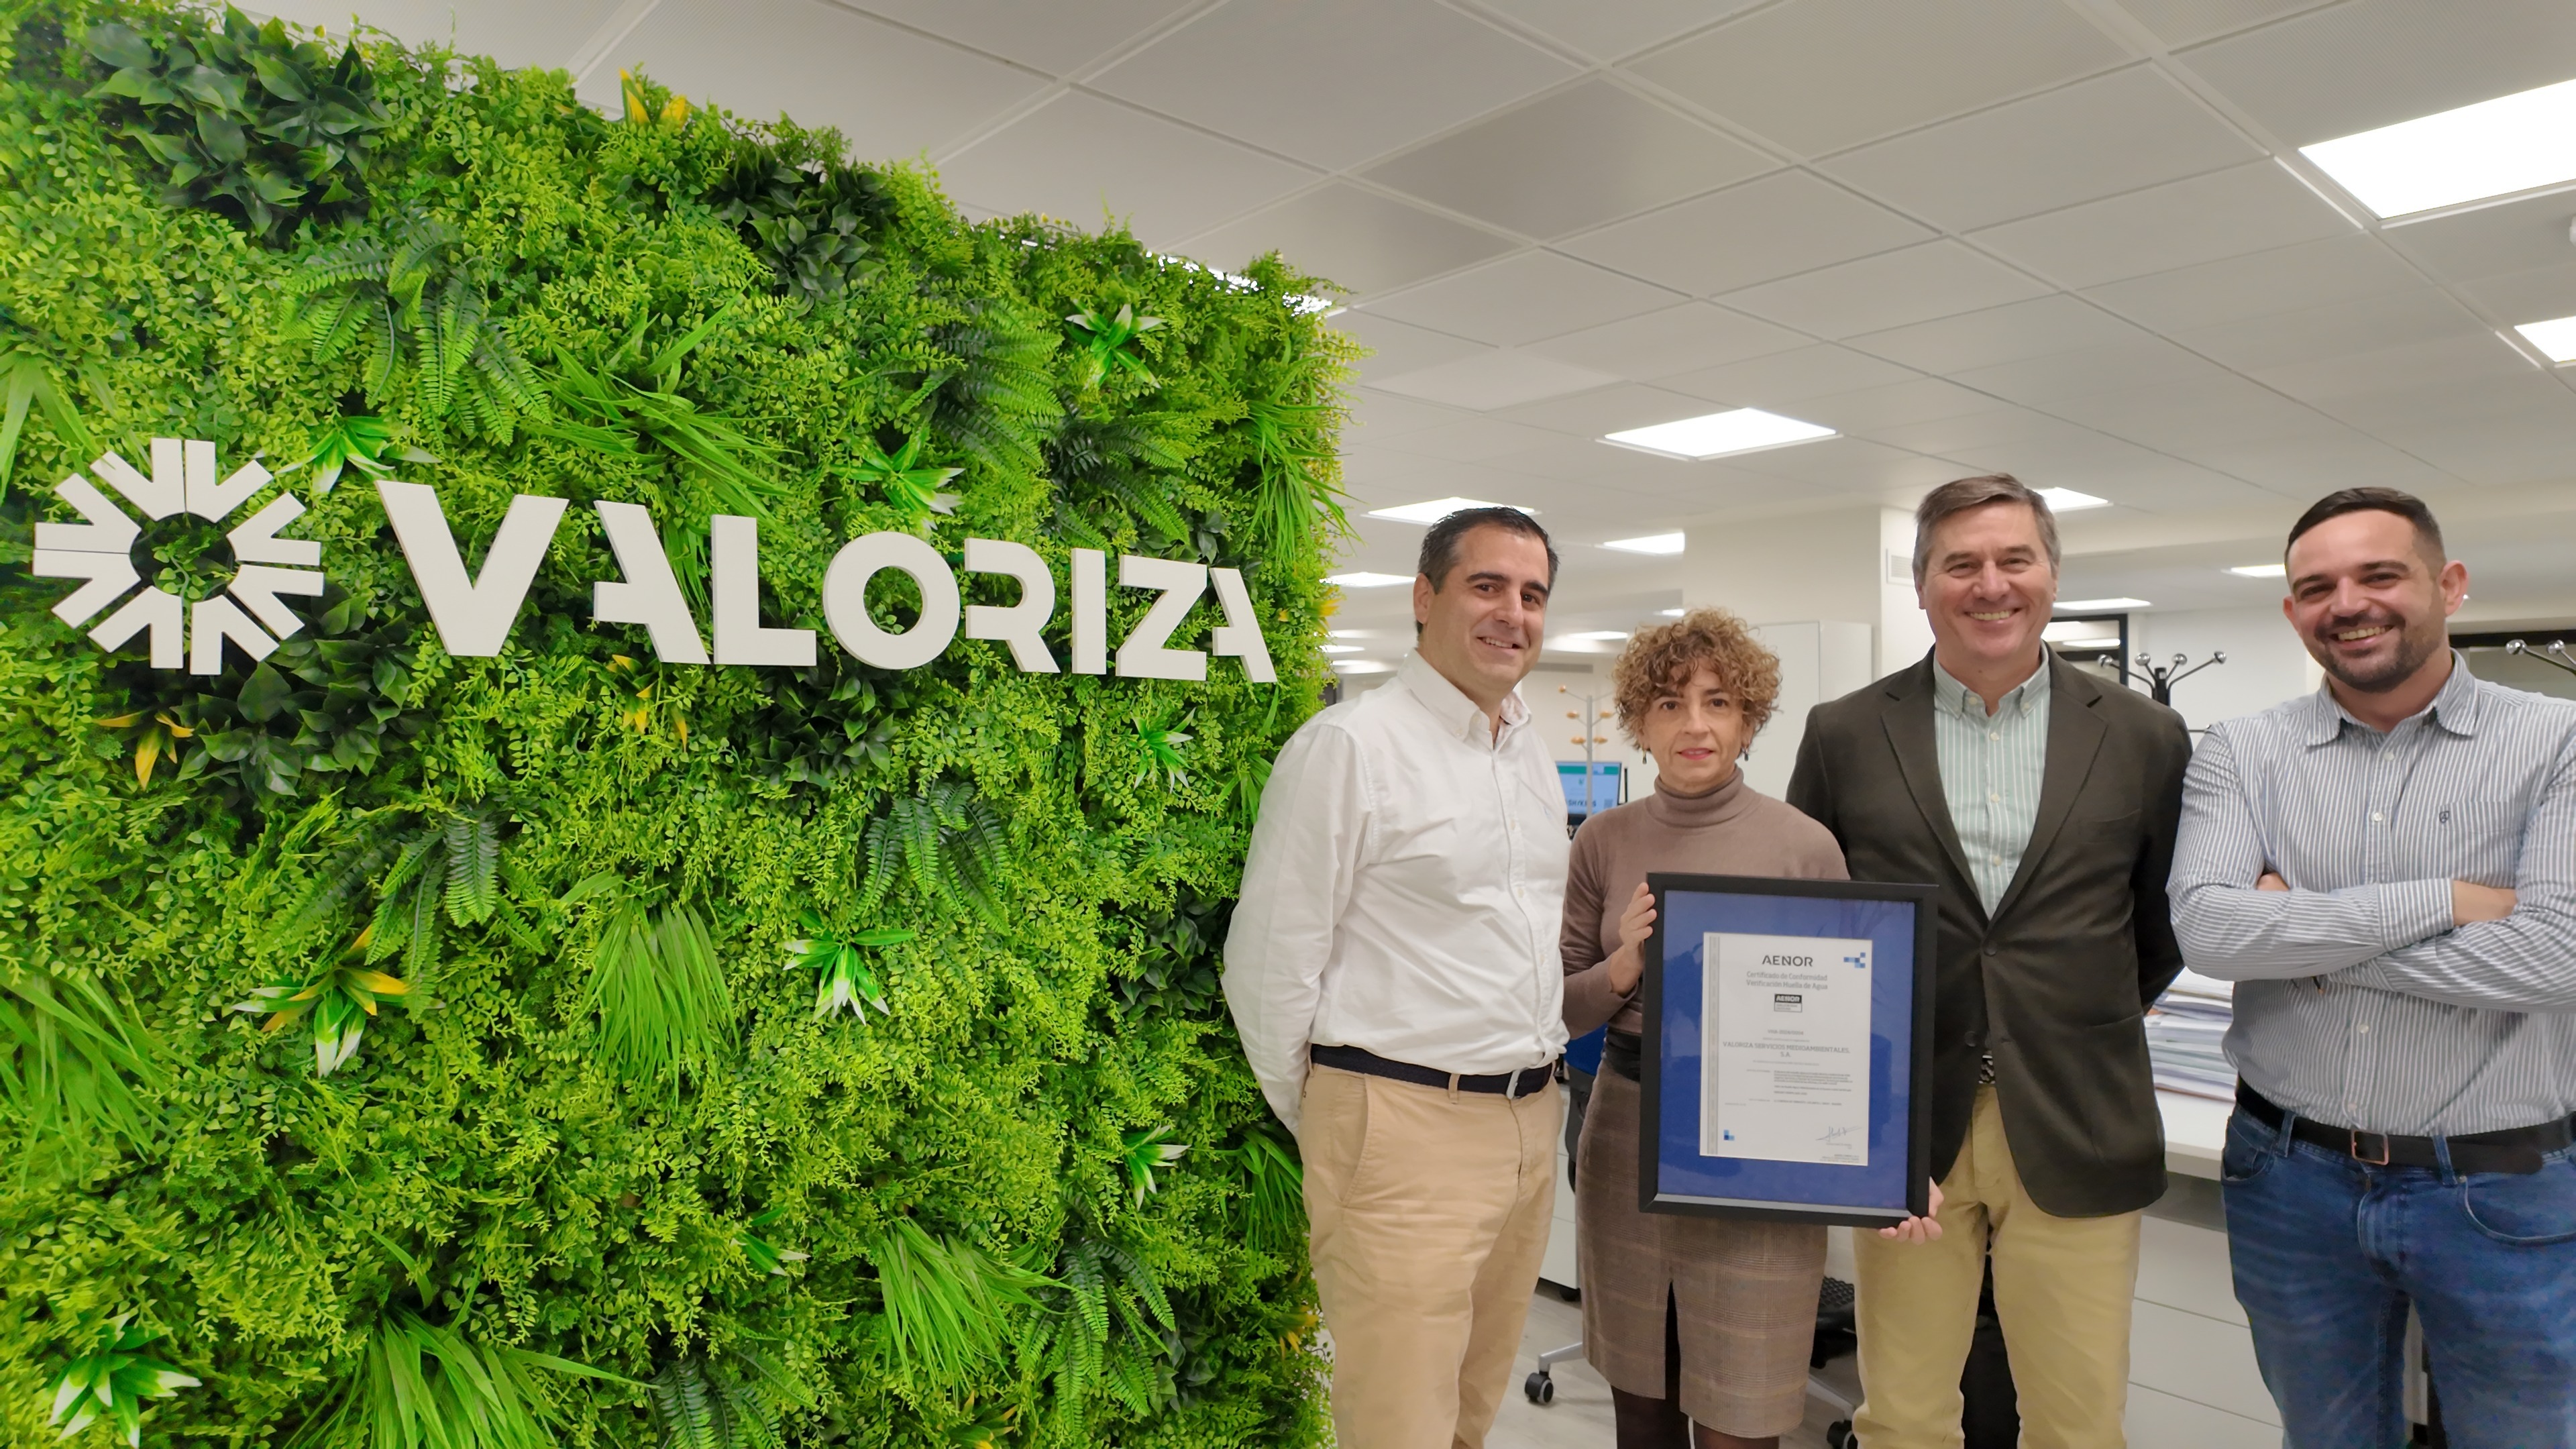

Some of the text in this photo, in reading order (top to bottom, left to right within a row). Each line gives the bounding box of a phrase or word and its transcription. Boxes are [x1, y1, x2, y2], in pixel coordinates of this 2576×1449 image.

[374, 480, 1277, 684] VALORIZA
[1762, 955, 1813, 967] AENOR
[1746, 971, 1780, 979] Certificado
[1788, 973, 1827, 981] Conformidad
[1746, 979, 1782, 987] Verificación
